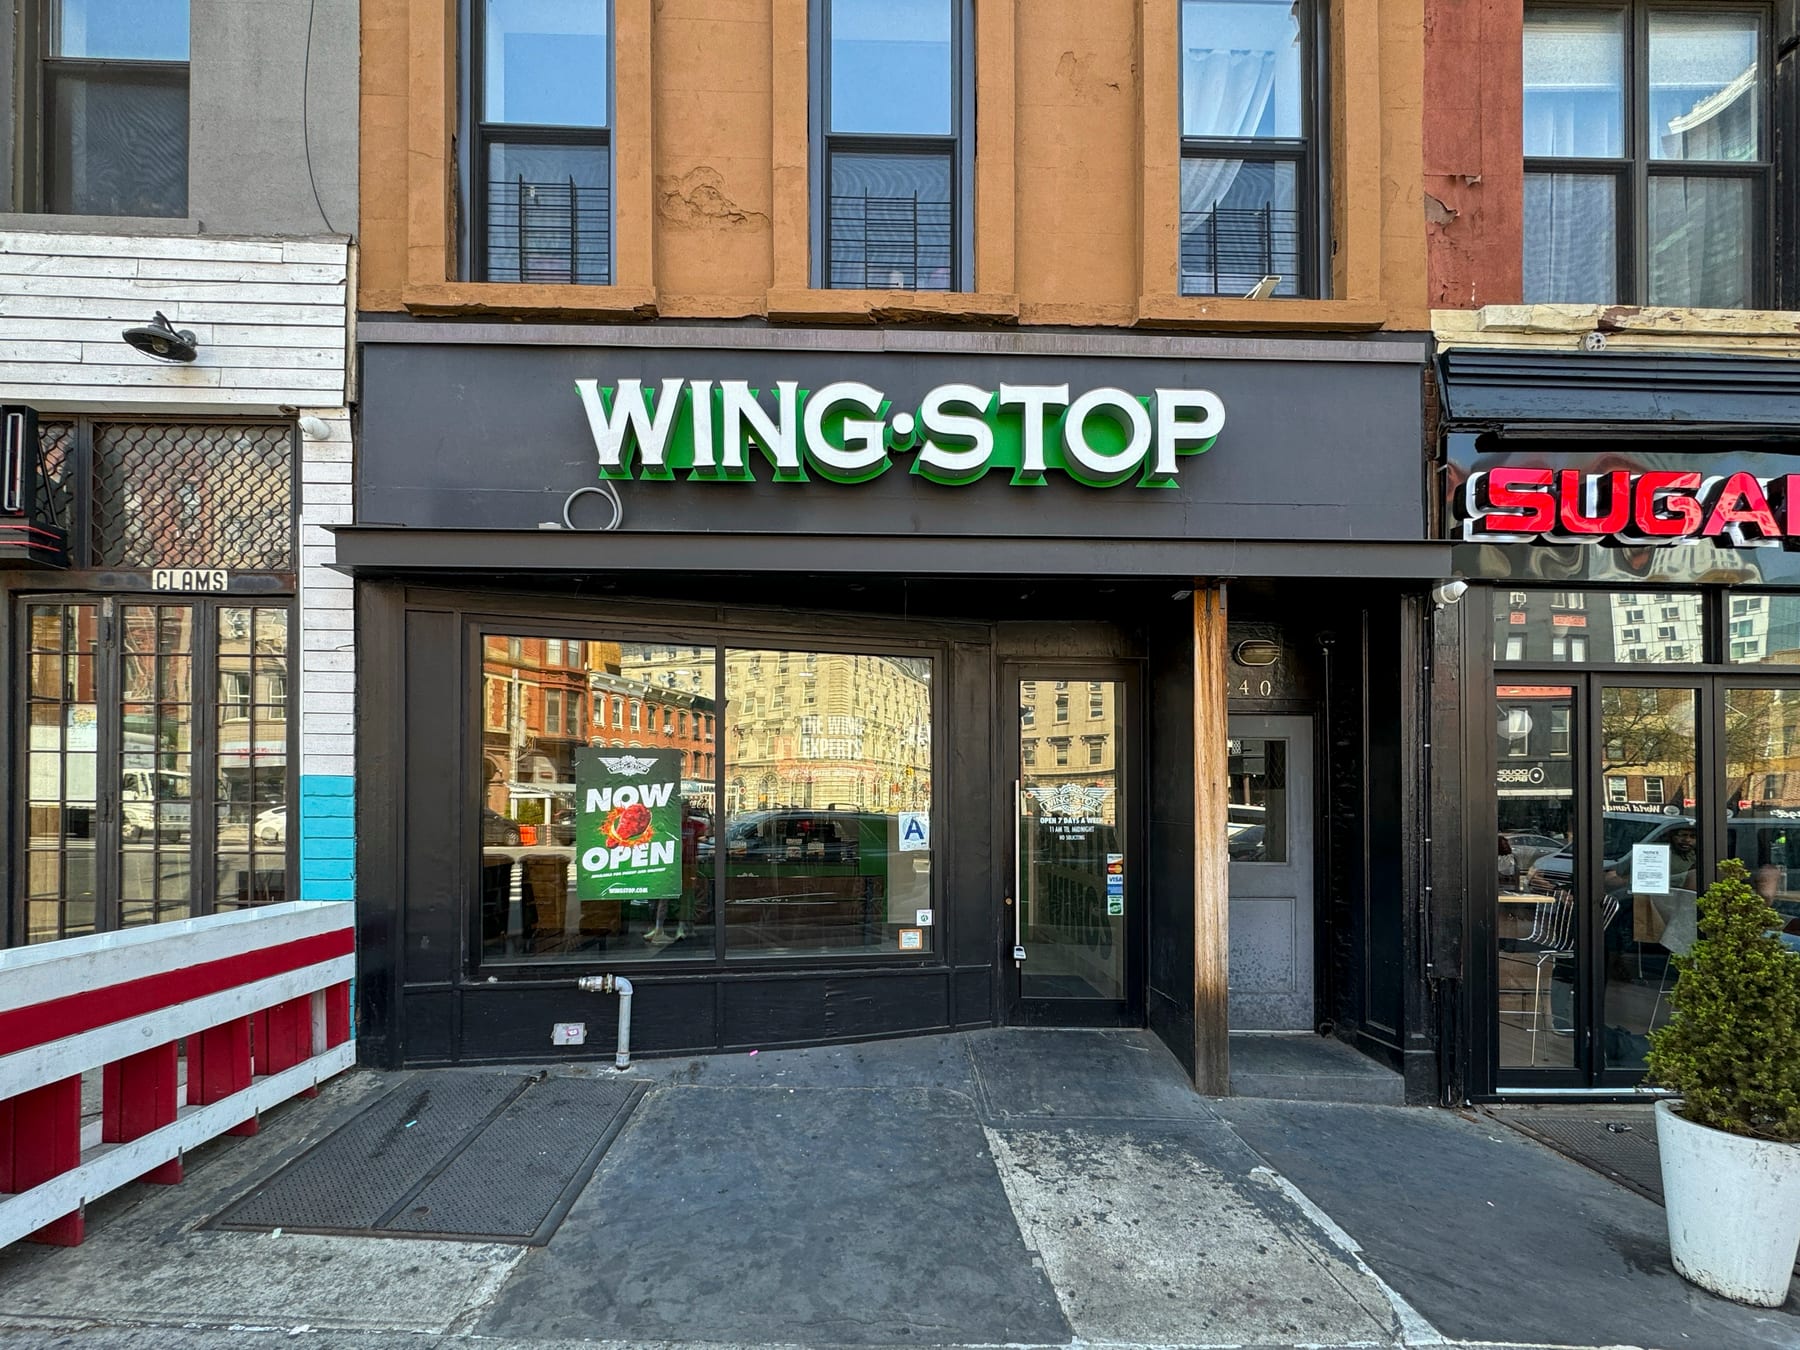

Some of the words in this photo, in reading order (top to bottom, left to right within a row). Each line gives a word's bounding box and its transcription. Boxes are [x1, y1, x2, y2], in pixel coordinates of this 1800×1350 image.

[1485, 466, 1800, 537] SUGA
[156, 571, 225, 591] CLAMS
[1227, 679, 1272, 697] 40
[586, 782, 675, 813] NOW
[904, 817, 925, 840] A
[1049, 825, 1055, 833] 11
[1055, 825, 1063, 833] AM
[581, 840, 676, 872] OPEN
